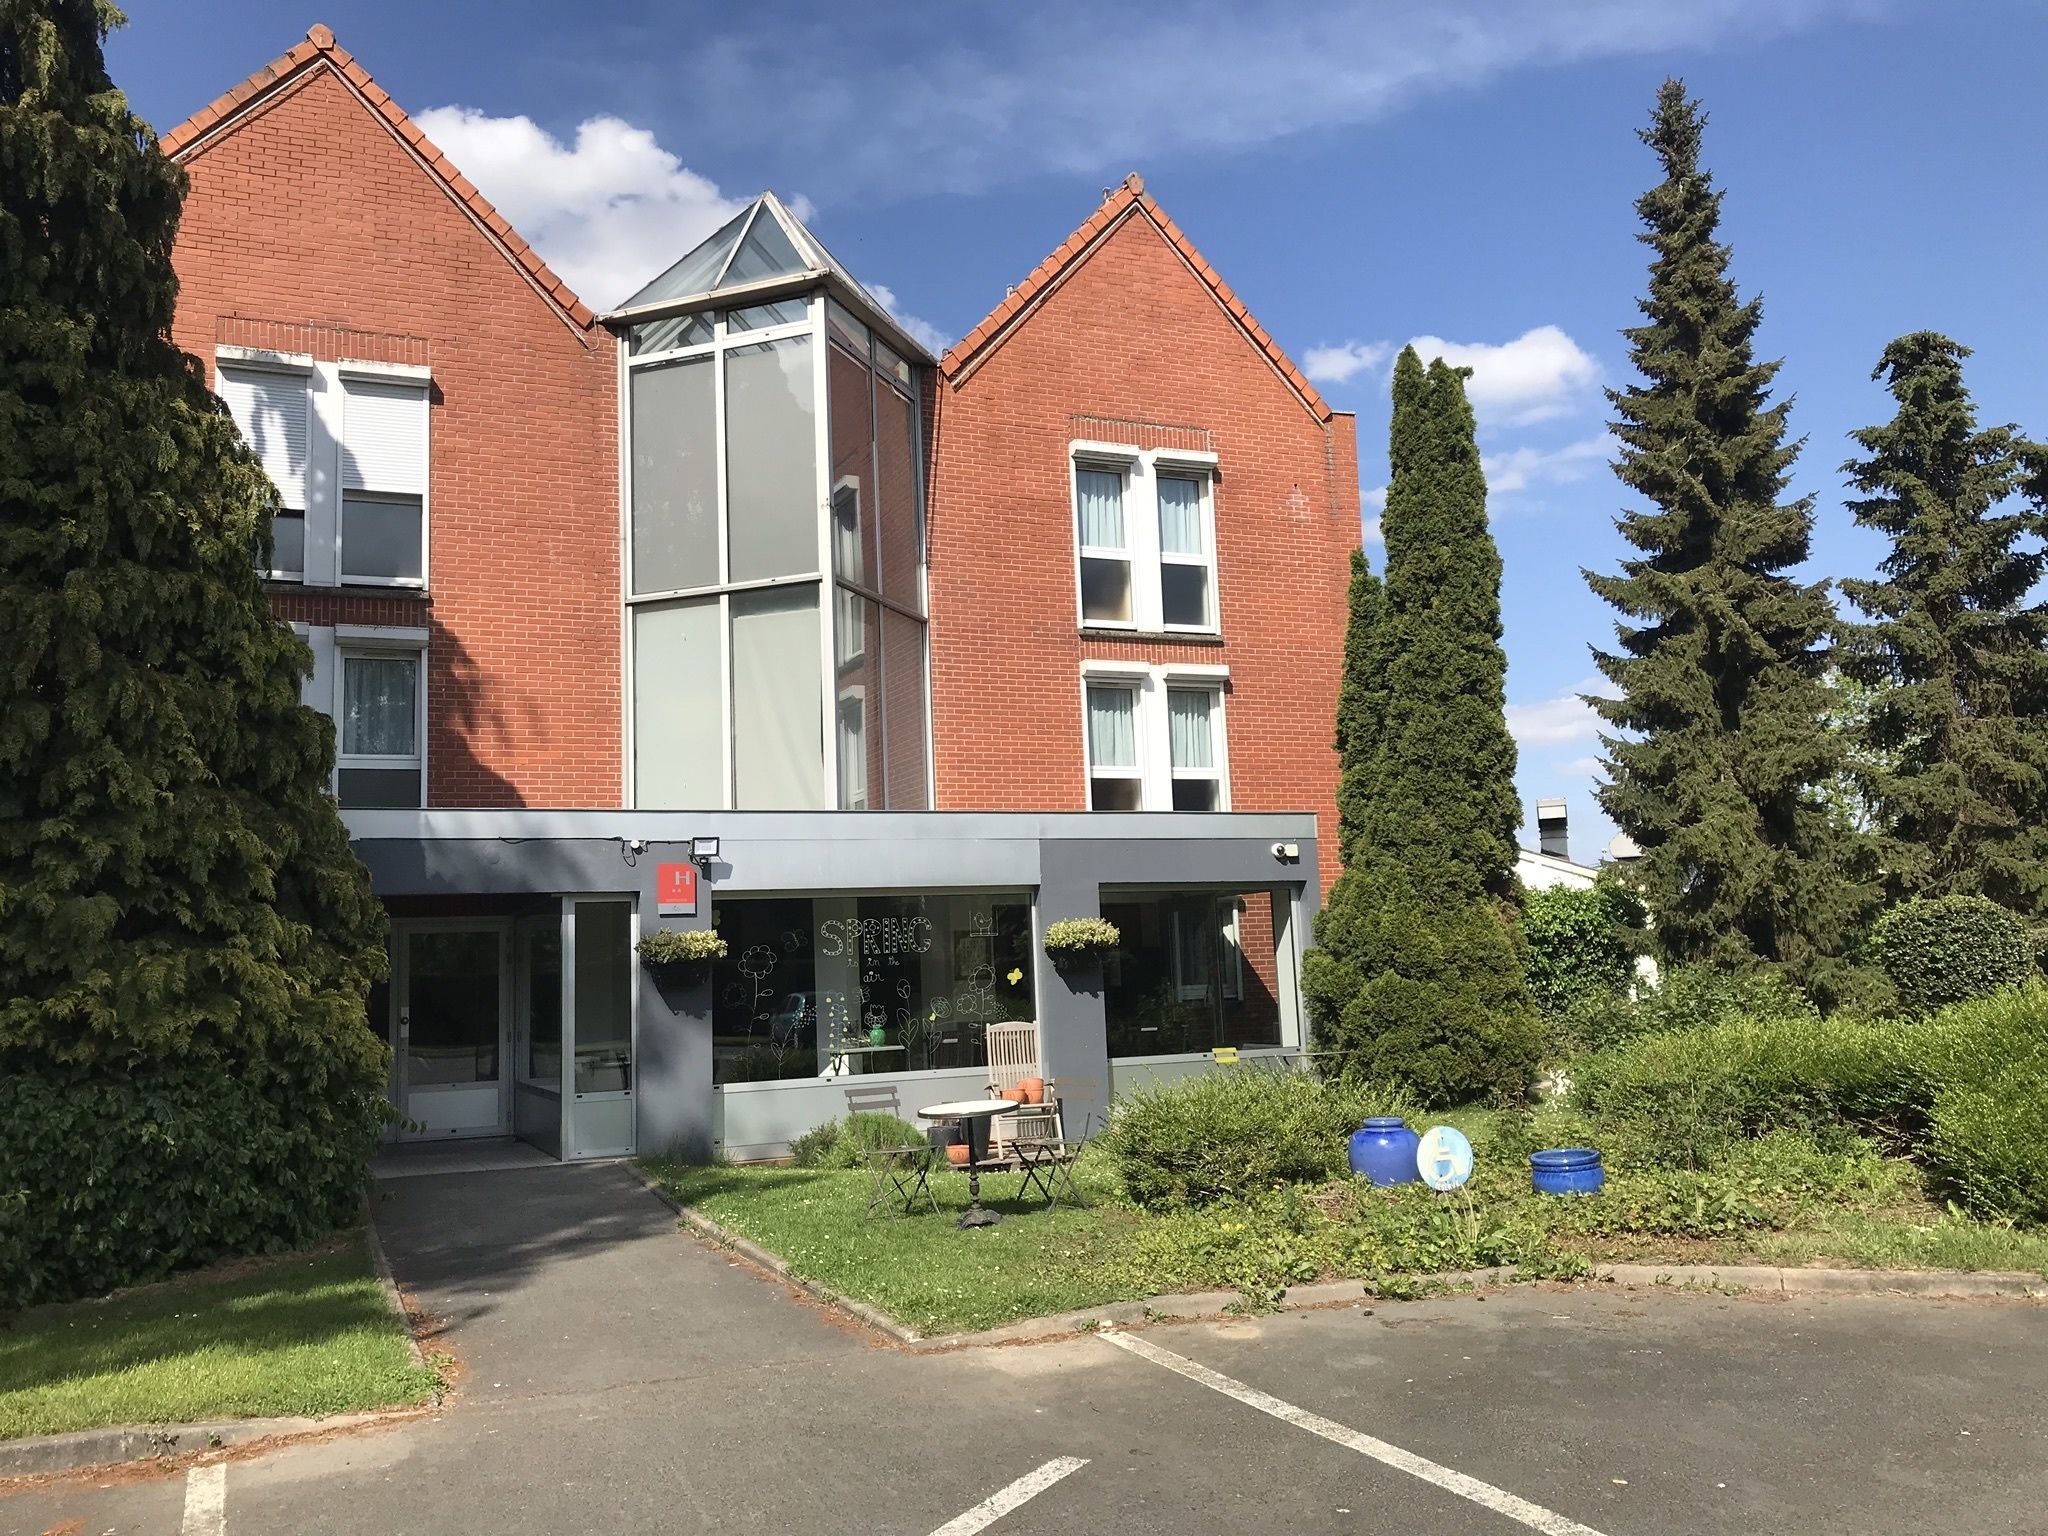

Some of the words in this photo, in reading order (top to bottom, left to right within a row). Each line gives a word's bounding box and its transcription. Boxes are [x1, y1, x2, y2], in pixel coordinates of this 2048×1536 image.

[675, 871, 691, 886] H
[820, 916, 933, 957] SPRING
[865, 957, 881, 968] in
[887, 955, 901, 966] the
[862, 970, 885, 983] air
